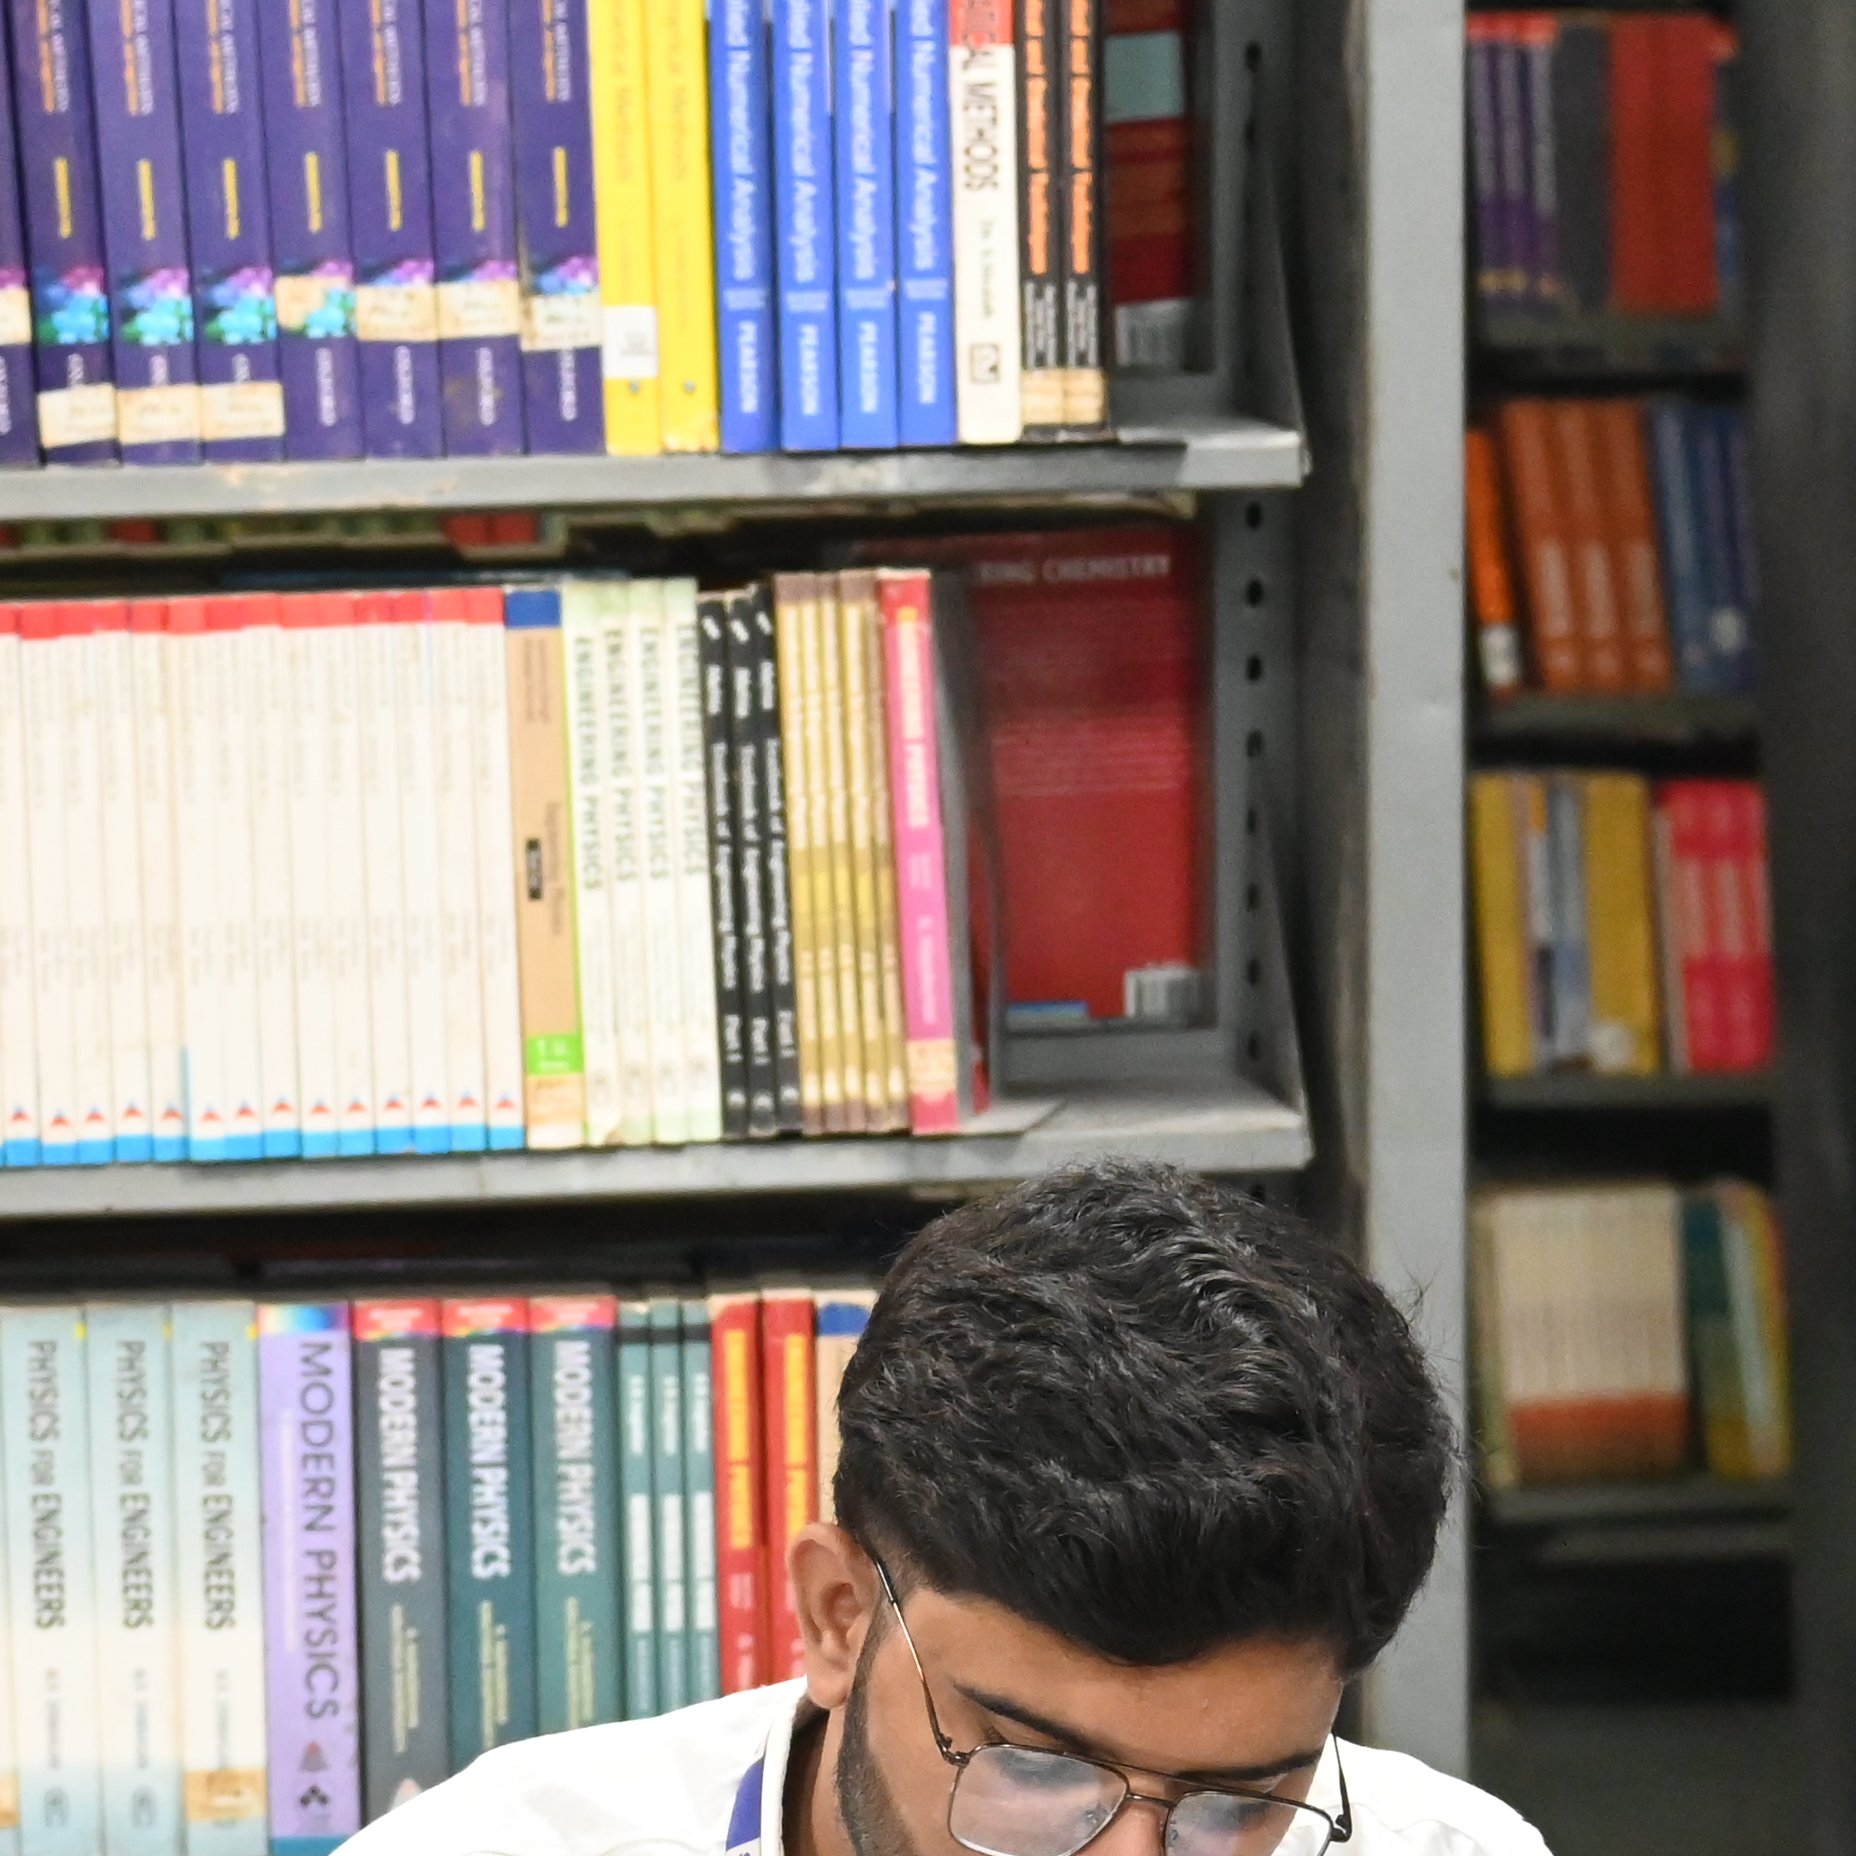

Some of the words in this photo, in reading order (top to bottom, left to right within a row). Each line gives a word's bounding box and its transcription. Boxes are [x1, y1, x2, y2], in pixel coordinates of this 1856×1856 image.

[728, 53, 760, 173] Numerical
[790, 54, 821, 175] Numerical
[851, 53, 879, 171] Numerical
[910, 42, 938, 163] Numerical
[966, 82, 997, 191] METHODS
[730, 179, 759, 280] Analysis
[792, 183, 822, 281] Analysis
[850, 179, 880, 278] Analysis
[910, 170, 939, 269] Analysis
[739, 322, 757, 413] PEARSON
[801, 325, 819, 415] PEARSON
[859, 322, 878, 412] PEARSON
[918, 313, 936, 403] PEARSON
[575, 637, 601, 786] ENGINEERING
[606, 629, 633, 778] ENGINEERING
[640, 628, 666, 776] ENGINEERING
[674, 625, 701, 771] ENGINEERING
[581, 794, 603, 890] PHYSICS
[615, 787, 637, 883] PHYSICS
[647, 786, 668, 881] PHYSICS
[682, 782, 703, 876] PHYSICS
[713, 845, 732, 933] Engineering
[742, 848, 761, 935] Engineering
[768, 841, 785, 927] Engineering
[717, 935, 737, 989] Physics
[748, 939, 765, 991] Physics
[776, 930, 792, 984] Physics
[29, 1341, 59, 1441] PHYSICS
[117, 1341, 147, 1441] PHYSICS
[200, 1342, 230, 1442] PHYSICS
[299, 1342, 336, 1533] MODERN
[378, 1349, 415, 1467] MODERN
[467, 1346, 503, 1463] MODERN
[553, 1341, 589, 1457] MODERN
[33, 1451, 56, 1485] FOR
[120, 1450, 142, 1484] FOR
[203, 1451, 226, 1487] FOR
[30, 1494, 65, 1630] ENGINEERS
[120, 1494, 153, 1628] ENGINEERS
[203, 1495, 236, 1631] ENGINEERS
[383, 1473, 420, 1583] PHYSICS
[472, 1469, 509, 1577] PHYSICS
[558, 1464, 595, 1574] PHYSICS
[305, 1550, 339, 1719] PHYSICS
